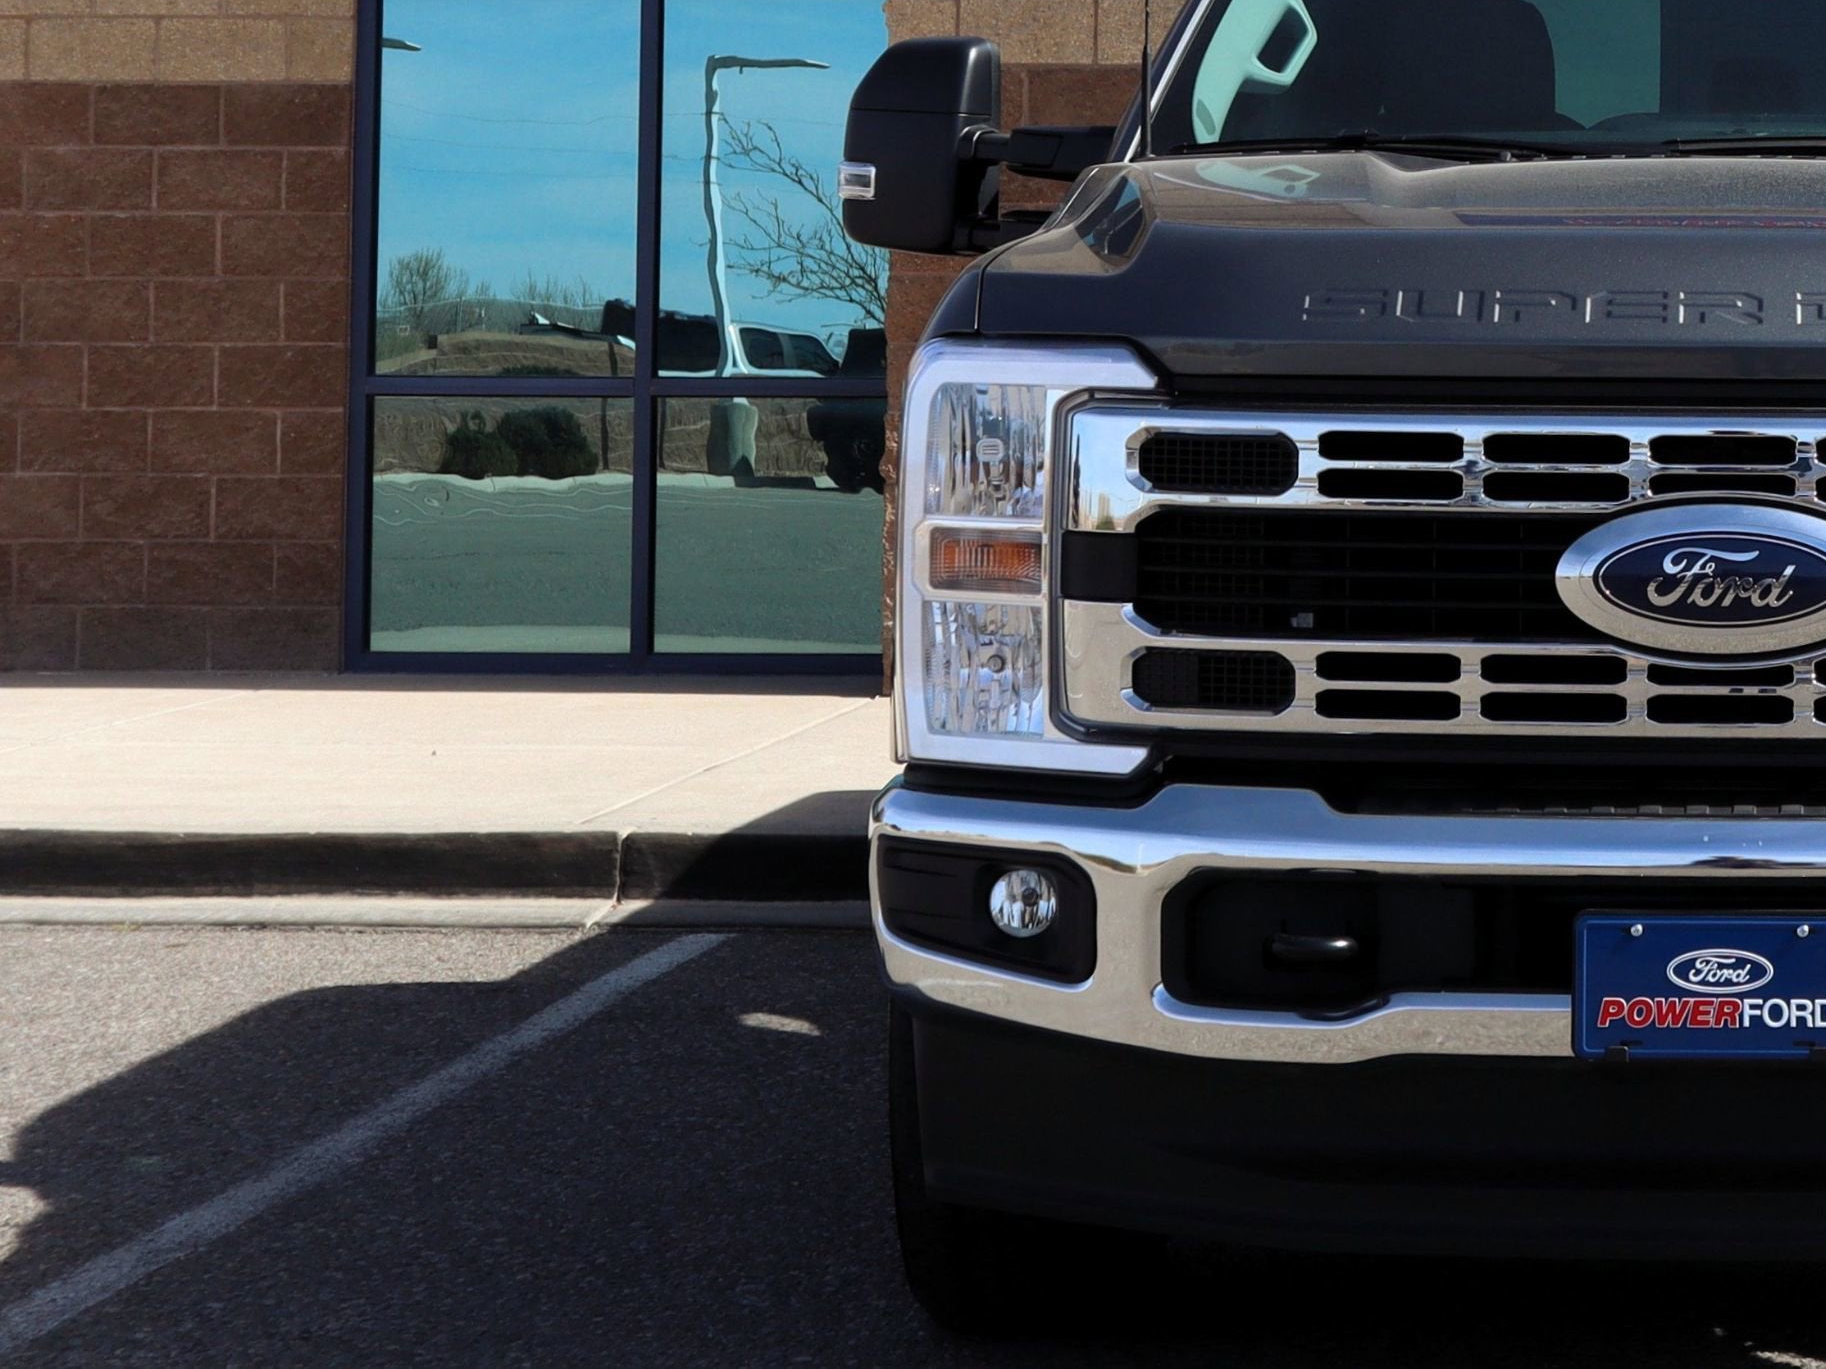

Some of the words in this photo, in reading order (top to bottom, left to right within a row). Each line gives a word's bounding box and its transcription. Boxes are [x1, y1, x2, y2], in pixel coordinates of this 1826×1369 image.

[1302, 288, 1764, 325] SUPER
[1647, 547, 1795, 608] Ford
[1689, 957, 1750, 984] Ford
